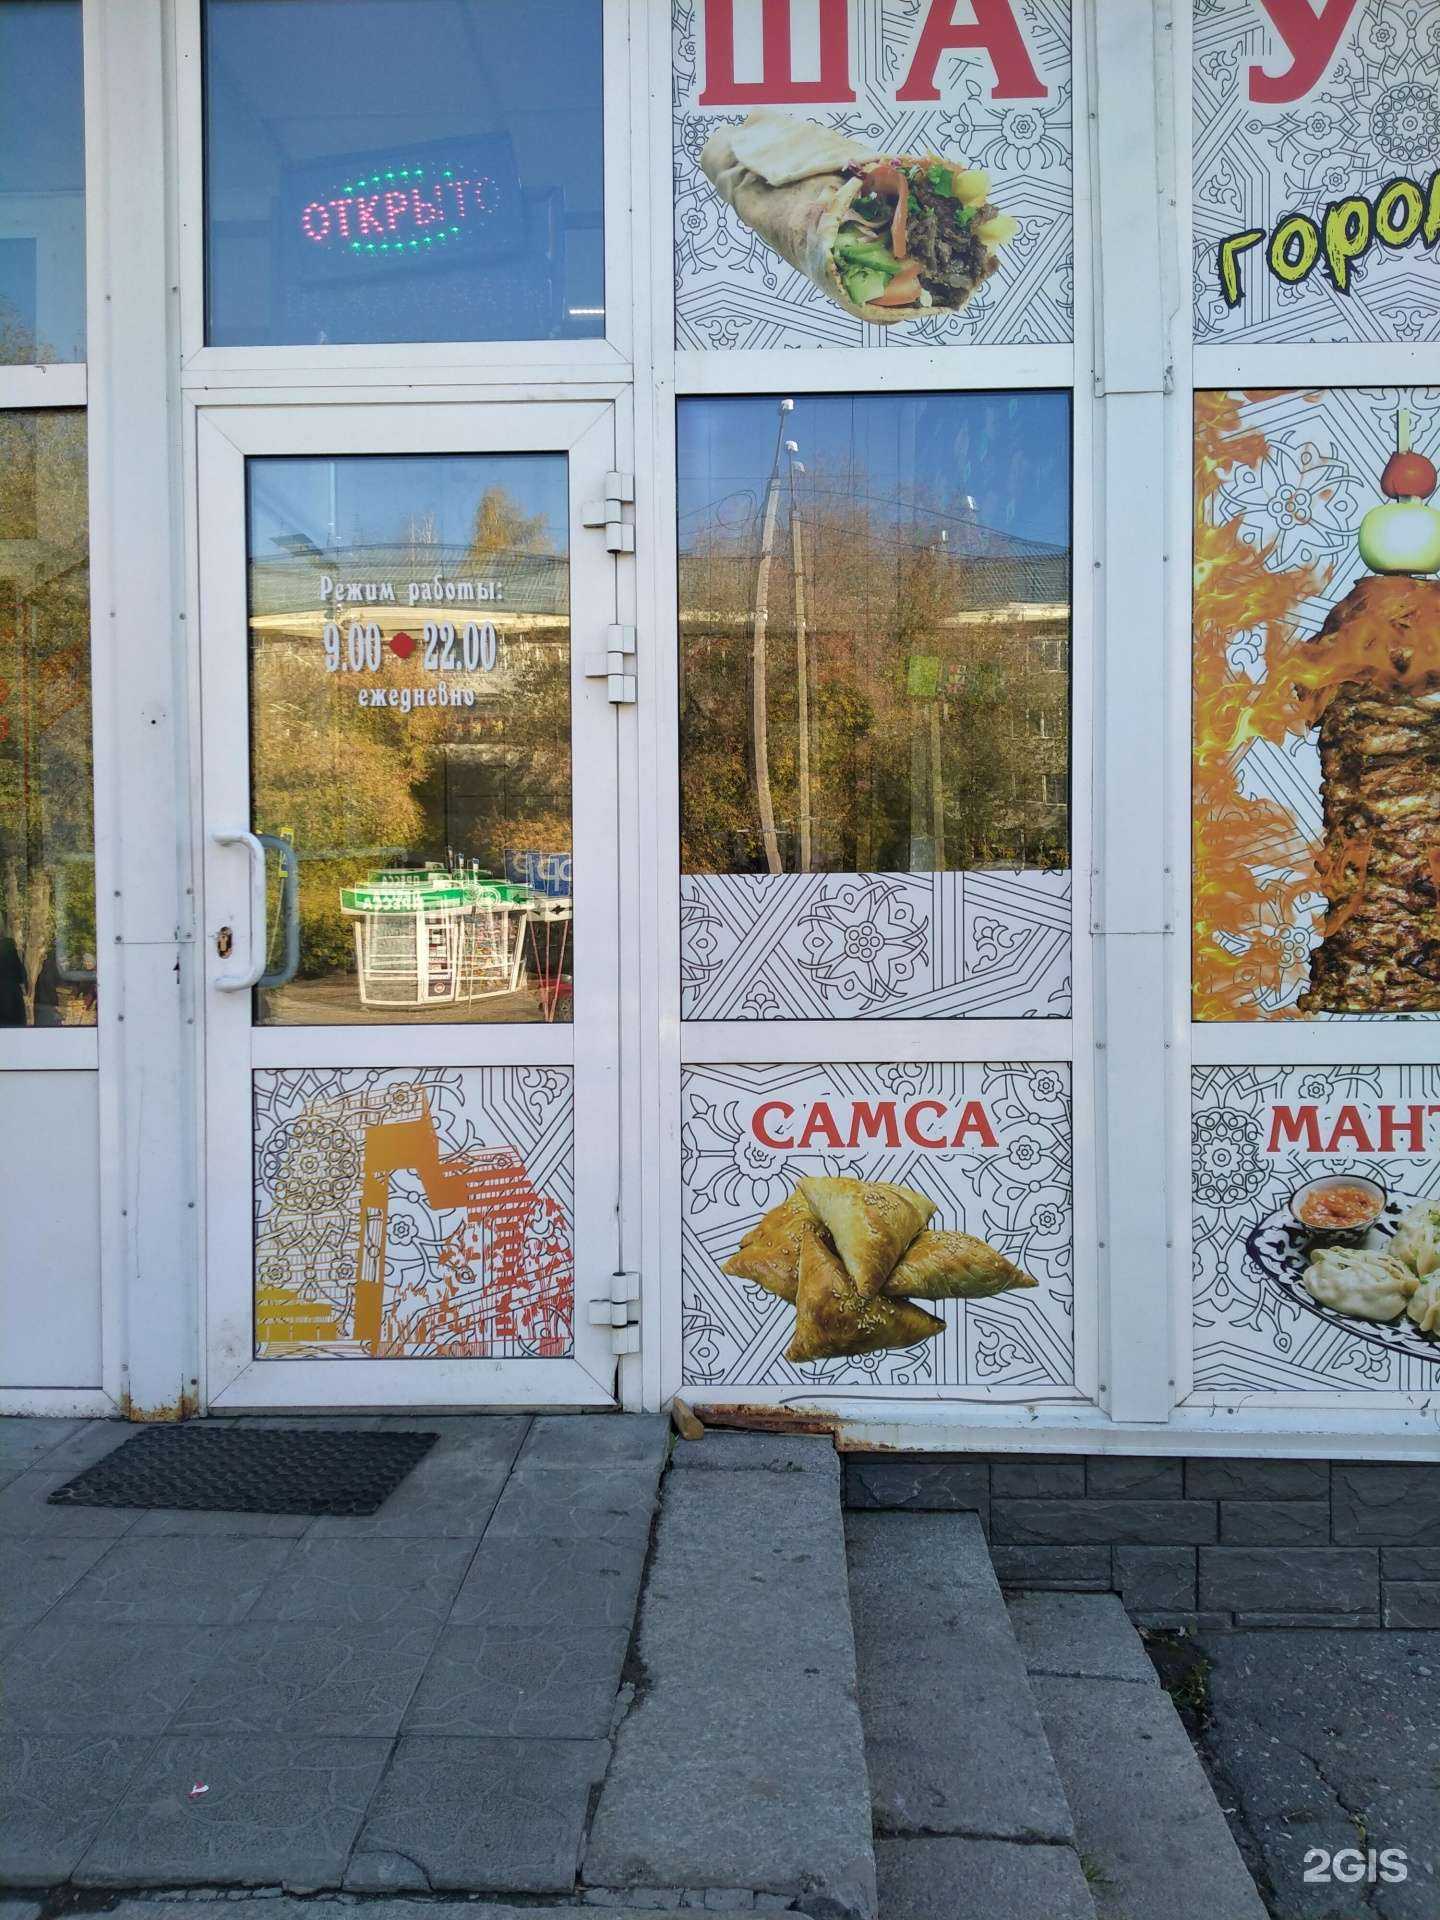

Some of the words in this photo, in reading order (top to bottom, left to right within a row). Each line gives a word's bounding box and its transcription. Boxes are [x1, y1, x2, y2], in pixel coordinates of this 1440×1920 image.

[698, 0, 1049, 106] ША
[302, 176, 500, 241] ОТКРЫТО
[319, 575, 396, 601] Режим
[408, 574, 503, 607] работы:
[323, 622, 382, 673] 9.00
[423, 620, 497, 673] 22.00
[358, 681, 476, 714] ежедневно
[751, 1100, 1000, 1149] САМСА
[1266, 1105, 1440, 1153] МАН
